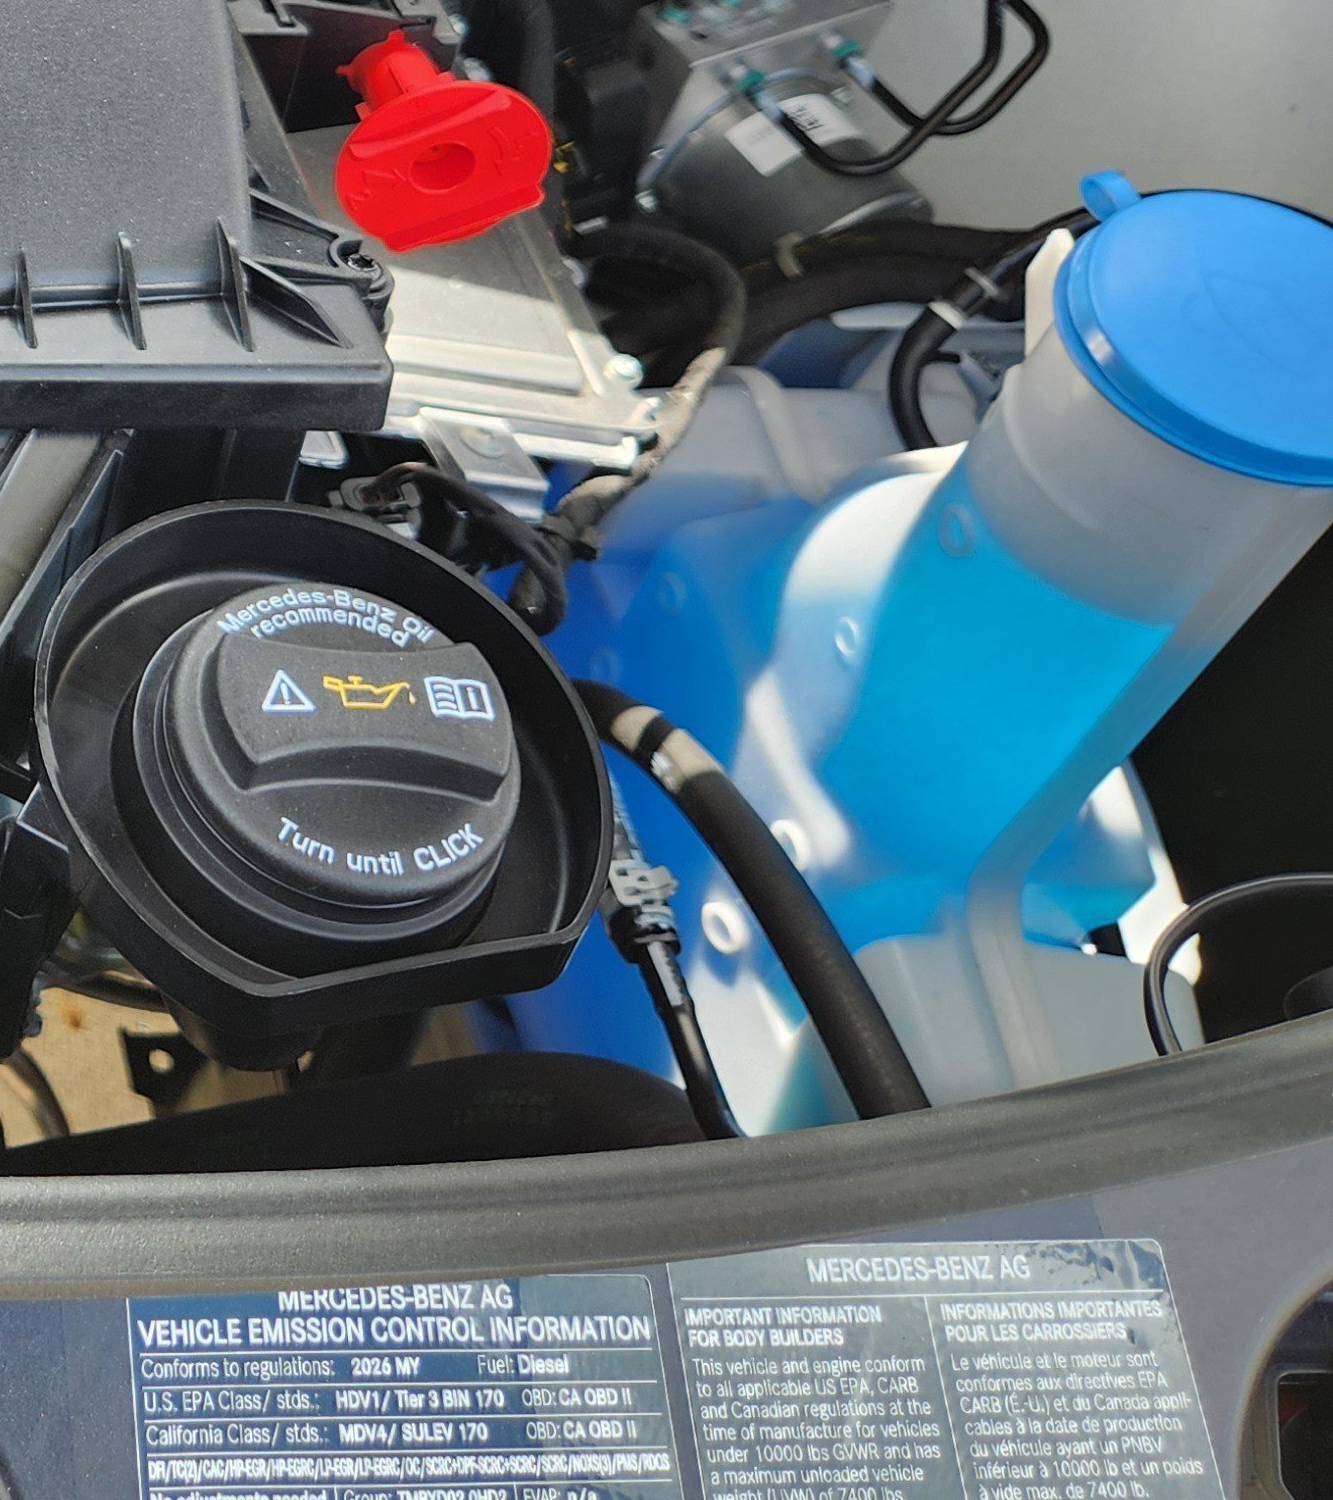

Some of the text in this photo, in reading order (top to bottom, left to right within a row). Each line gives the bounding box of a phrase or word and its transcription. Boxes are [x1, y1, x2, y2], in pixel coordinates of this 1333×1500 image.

[217, 588, 436, 643] Mercedes-Benz Oil
[250, 606, 410, 648] recommended
[277, 817, 484, 875] Turn until CLICK
[806, 1255, 1030, 1283] MERCEDES-BENZ AG
[278, 1285, 513, 1312] MERCEDES-BENZ AG
[684, 1306, 881, 1326] IMPORTANT INFORMATION
[941, 1301, 1162, 1321] INFORMATIONS IMPORTANTES
[137, 1315, 650, 1347] VEHICLE EMISSION CONTROL INFORMATION
[688, 1328, 844, 1347] FOR BODY BUILDERS
[945, 1322, 1127, 1342] POUR LES CARROSSIERS
[141, 1354, 569, 1380] Conforms to regulations: 2026 MY Fuel: Diesel
[692, 1356, 925, 1377] This vehicle and engine conform
[951, 1350, 1158, 1371] Le véhicule et le moteur sont
[696, 1376, 918, 1399] to all applicable US EPA, CARB
[956, 1371, 1168, 1392] conformes aux directives EPA
[143, 1387, 632, 1413] U.S. EPA Class/ stds.: HDV1/ Tier 3 BIN 170 OBD: CA OBD II
[701, 1399, 931, 1421] and Canadian regulations at the
[960, 1392, 1192, 1416] CARB (É.-U.) et du Canada appli-
[146, 1420, 636, 1446] California Class/ stds.: MDV4/ SULEV 170 OBD: CA OBD II
[703, 1420, 939, 1441] time of manufacture for vehicles
[965, 1414, 1182, 1436] cables à la date de production
[707, 1442, 940, 1464] under 10000 lbs GVWR and has
[970, 1436, 1162, 1459] du véhicule ayant un PNBV
